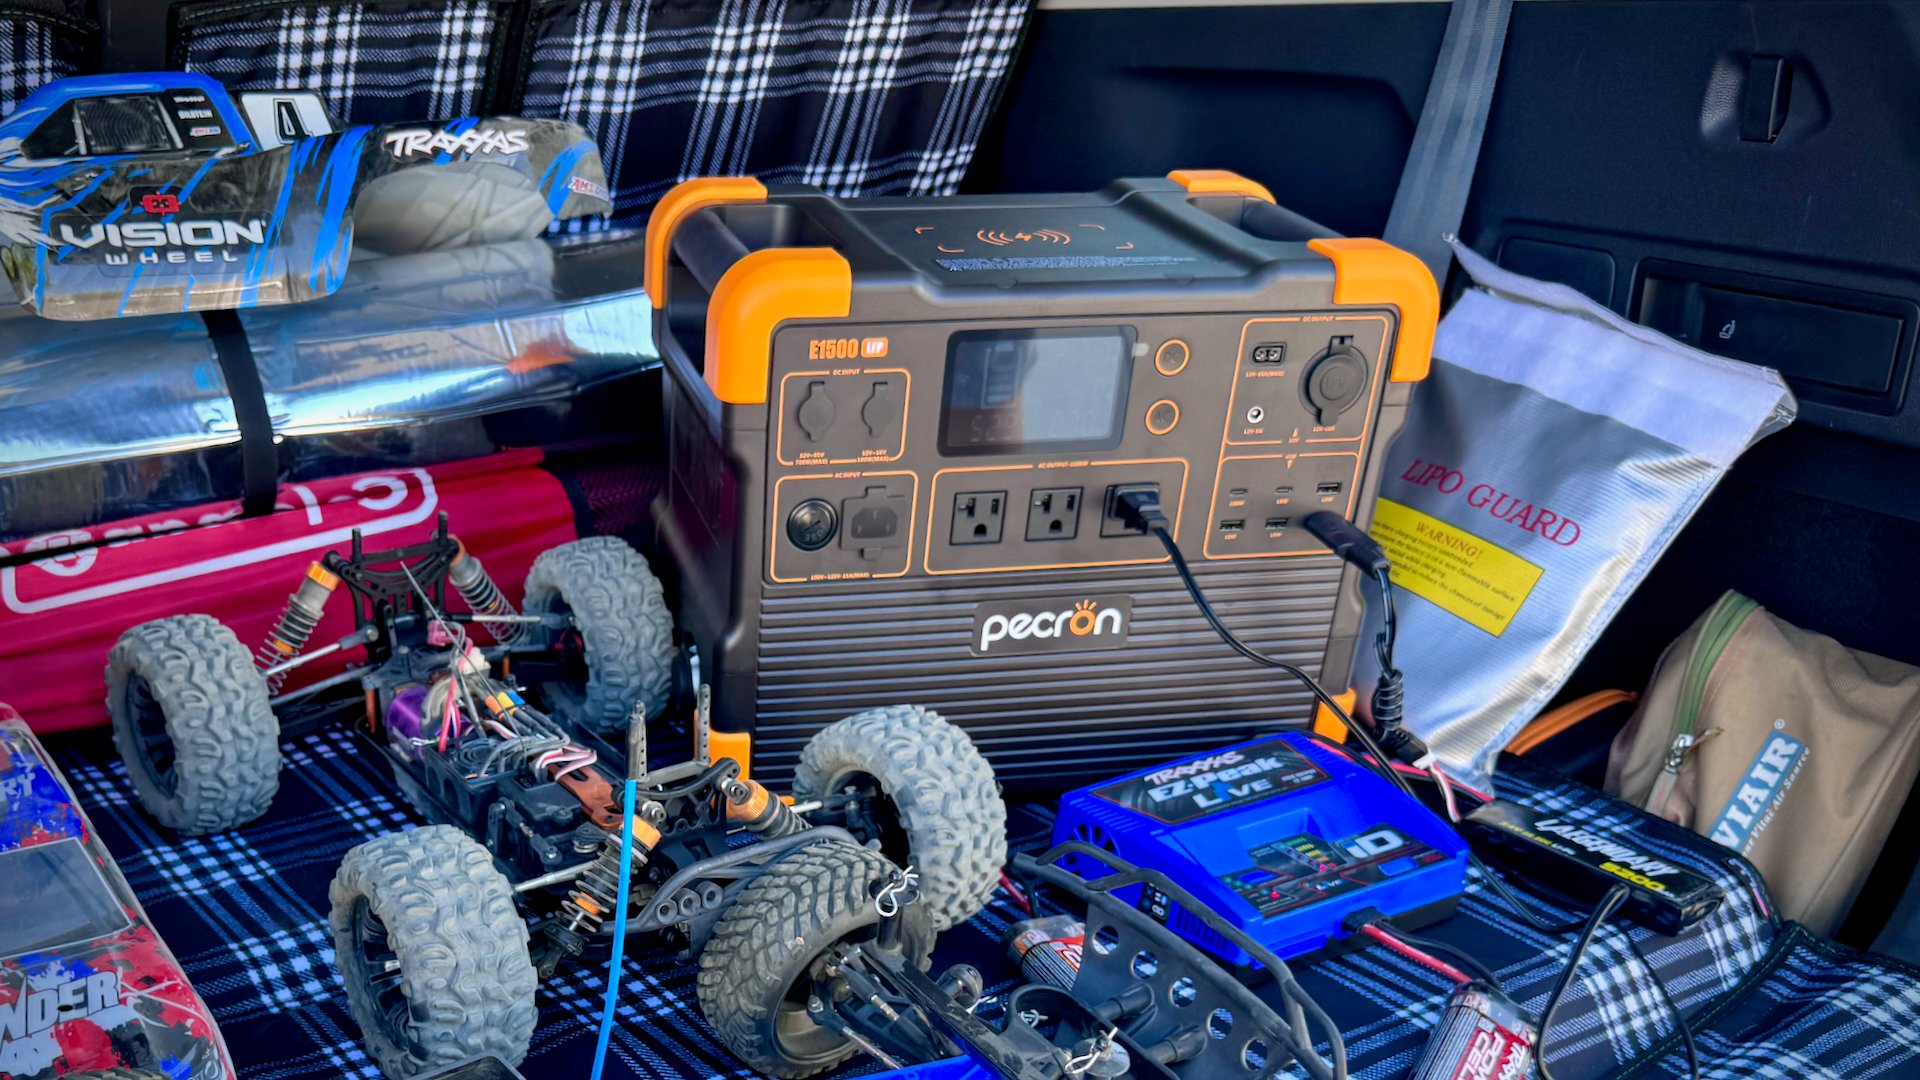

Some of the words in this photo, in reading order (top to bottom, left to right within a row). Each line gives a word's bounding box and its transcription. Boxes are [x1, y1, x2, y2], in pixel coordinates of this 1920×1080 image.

[385, 128, 530, 159] TRAXXAS
[60, 220, 266, 249] VISION
[105, 250, 238, 265] WHEEL
[809, 339, 859, 359] E1500
[866, 341, 884, 354] LFP
[1401, 459, 1465, 494] LIPO
[1467, 484, 1581, 547] GUARD
[1416, 521, 1484, 560] WARNING!
[980, 600, 1122, 651] pecron
[1143, 750, 1245, 785] TRAXXAS
[1192, 778, 1273, 809] LIVE
[1710, 737, 1799, 849] VIAIR
[1534, 818, 1680, 877] LAEGENDARY
[1599, 862, 1667, 892] 5200
